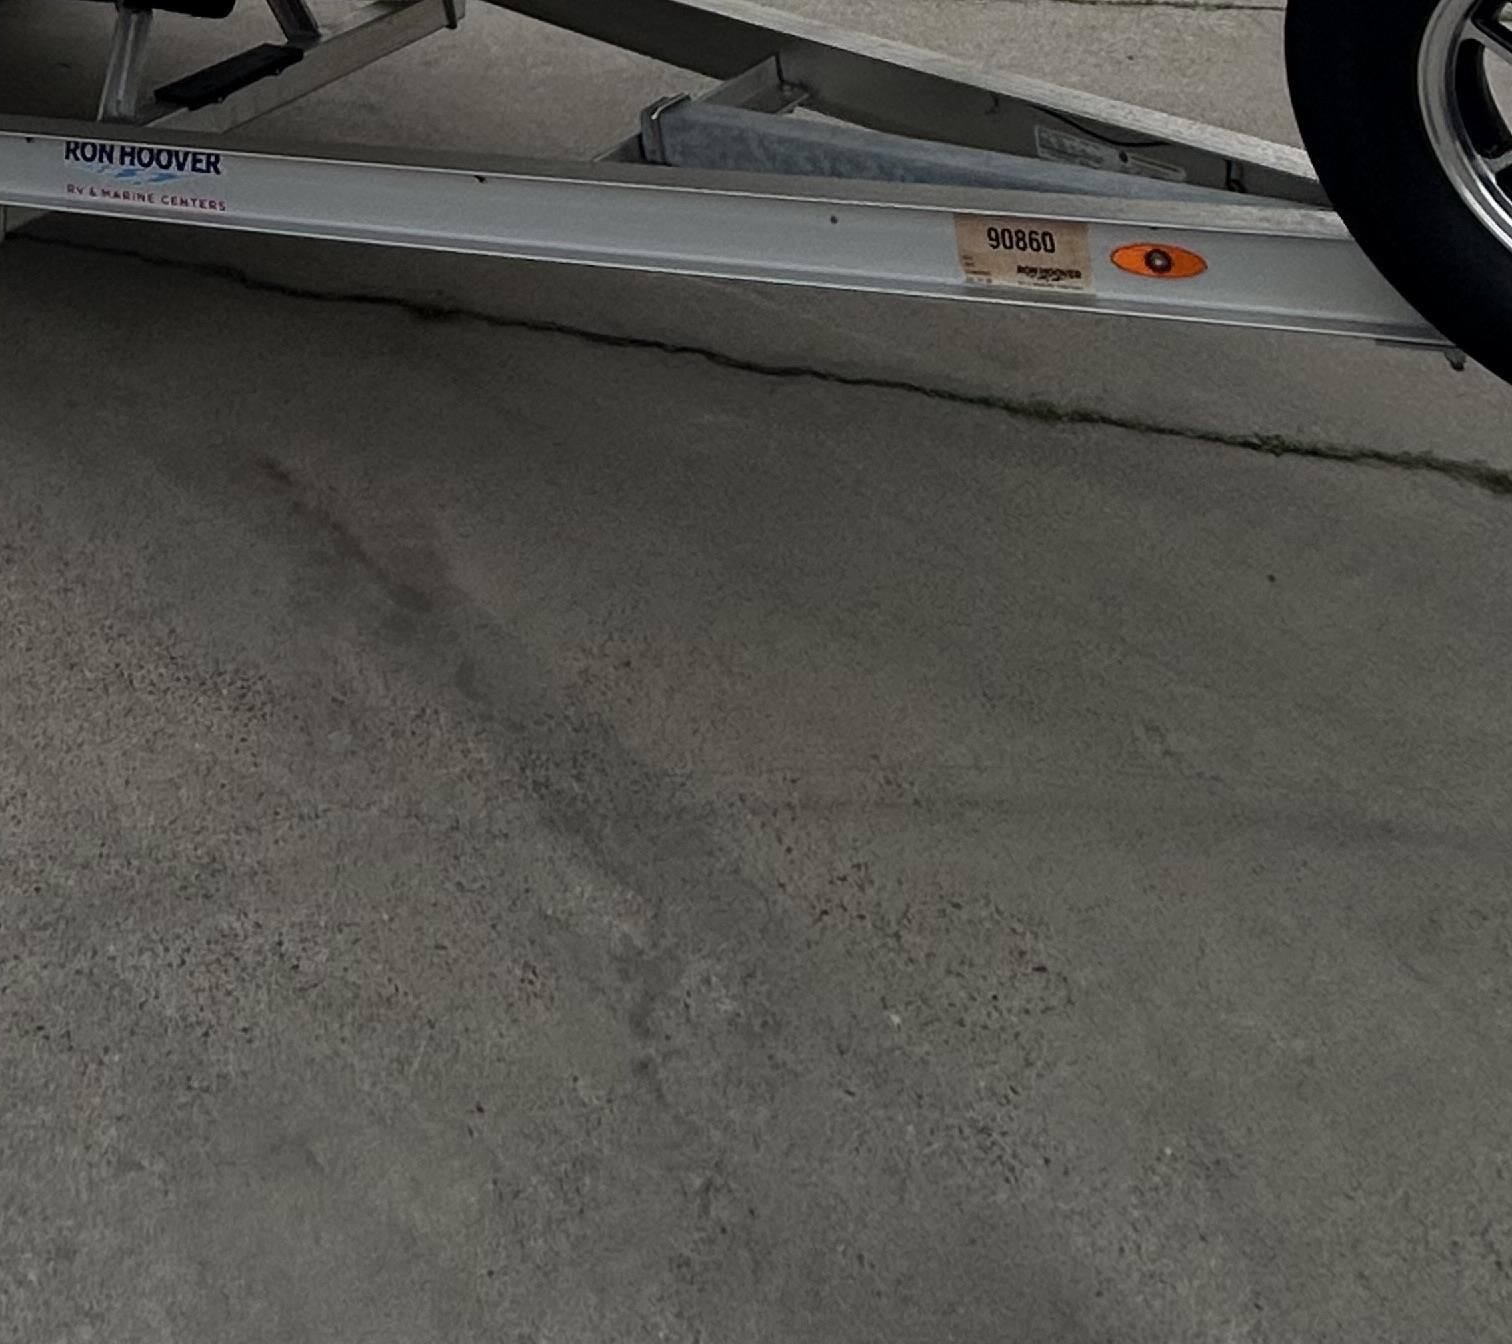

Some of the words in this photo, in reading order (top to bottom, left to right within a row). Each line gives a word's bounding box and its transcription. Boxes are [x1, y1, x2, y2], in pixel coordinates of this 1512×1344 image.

[64, 140, 115, 165] RON
[118, 145, 222, 175] HOOVER
[66, 183, 85, 196] RV
[88, 185, 98, 198] &
[101, 188, 155, 205] MARINE
[160, 194, 227, 212] CENTERS
[986, 226, 1056, 254] 90860
